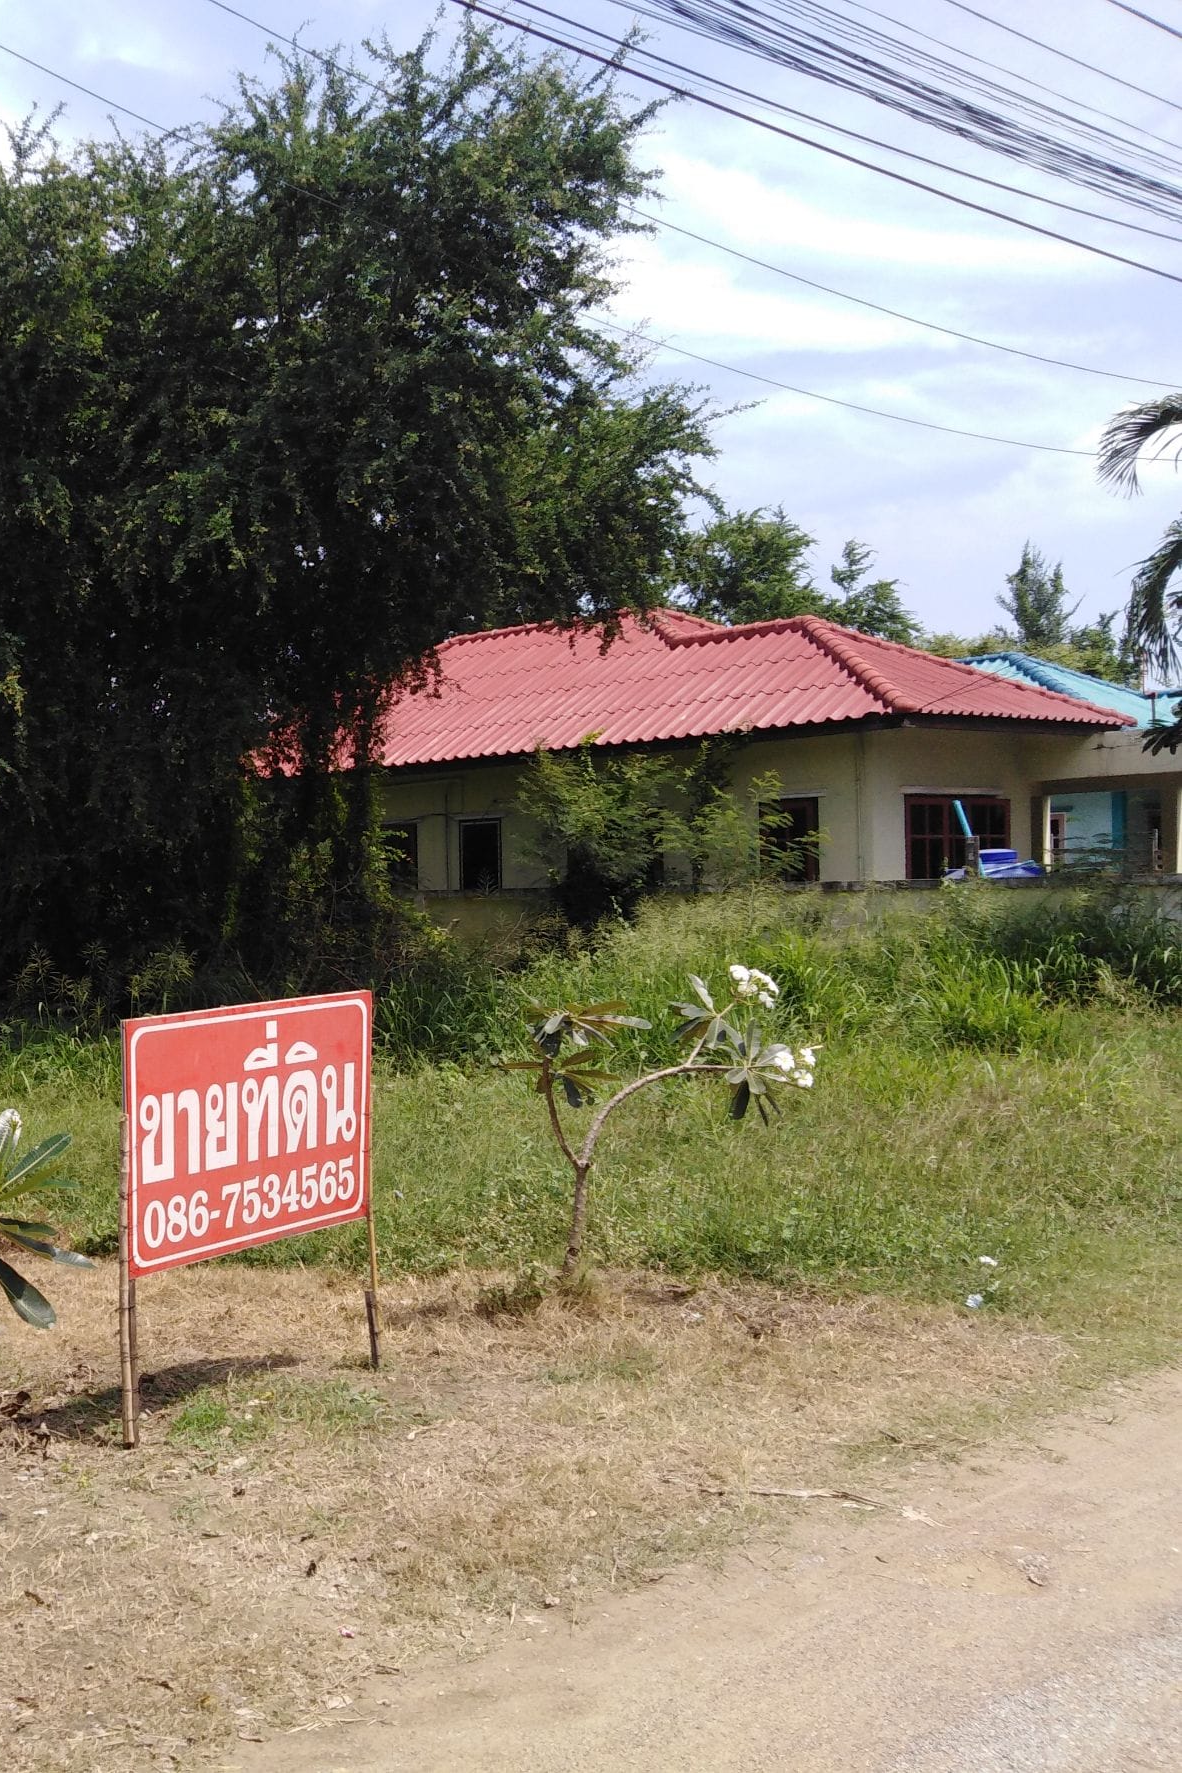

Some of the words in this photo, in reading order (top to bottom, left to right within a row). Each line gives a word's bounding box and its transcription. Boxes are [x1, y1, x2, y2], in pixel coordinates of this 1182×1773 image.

[139, 1020, 357, 1185] ขายที่ดิน
[143, 1154, 355, 1249] 086-7534565
